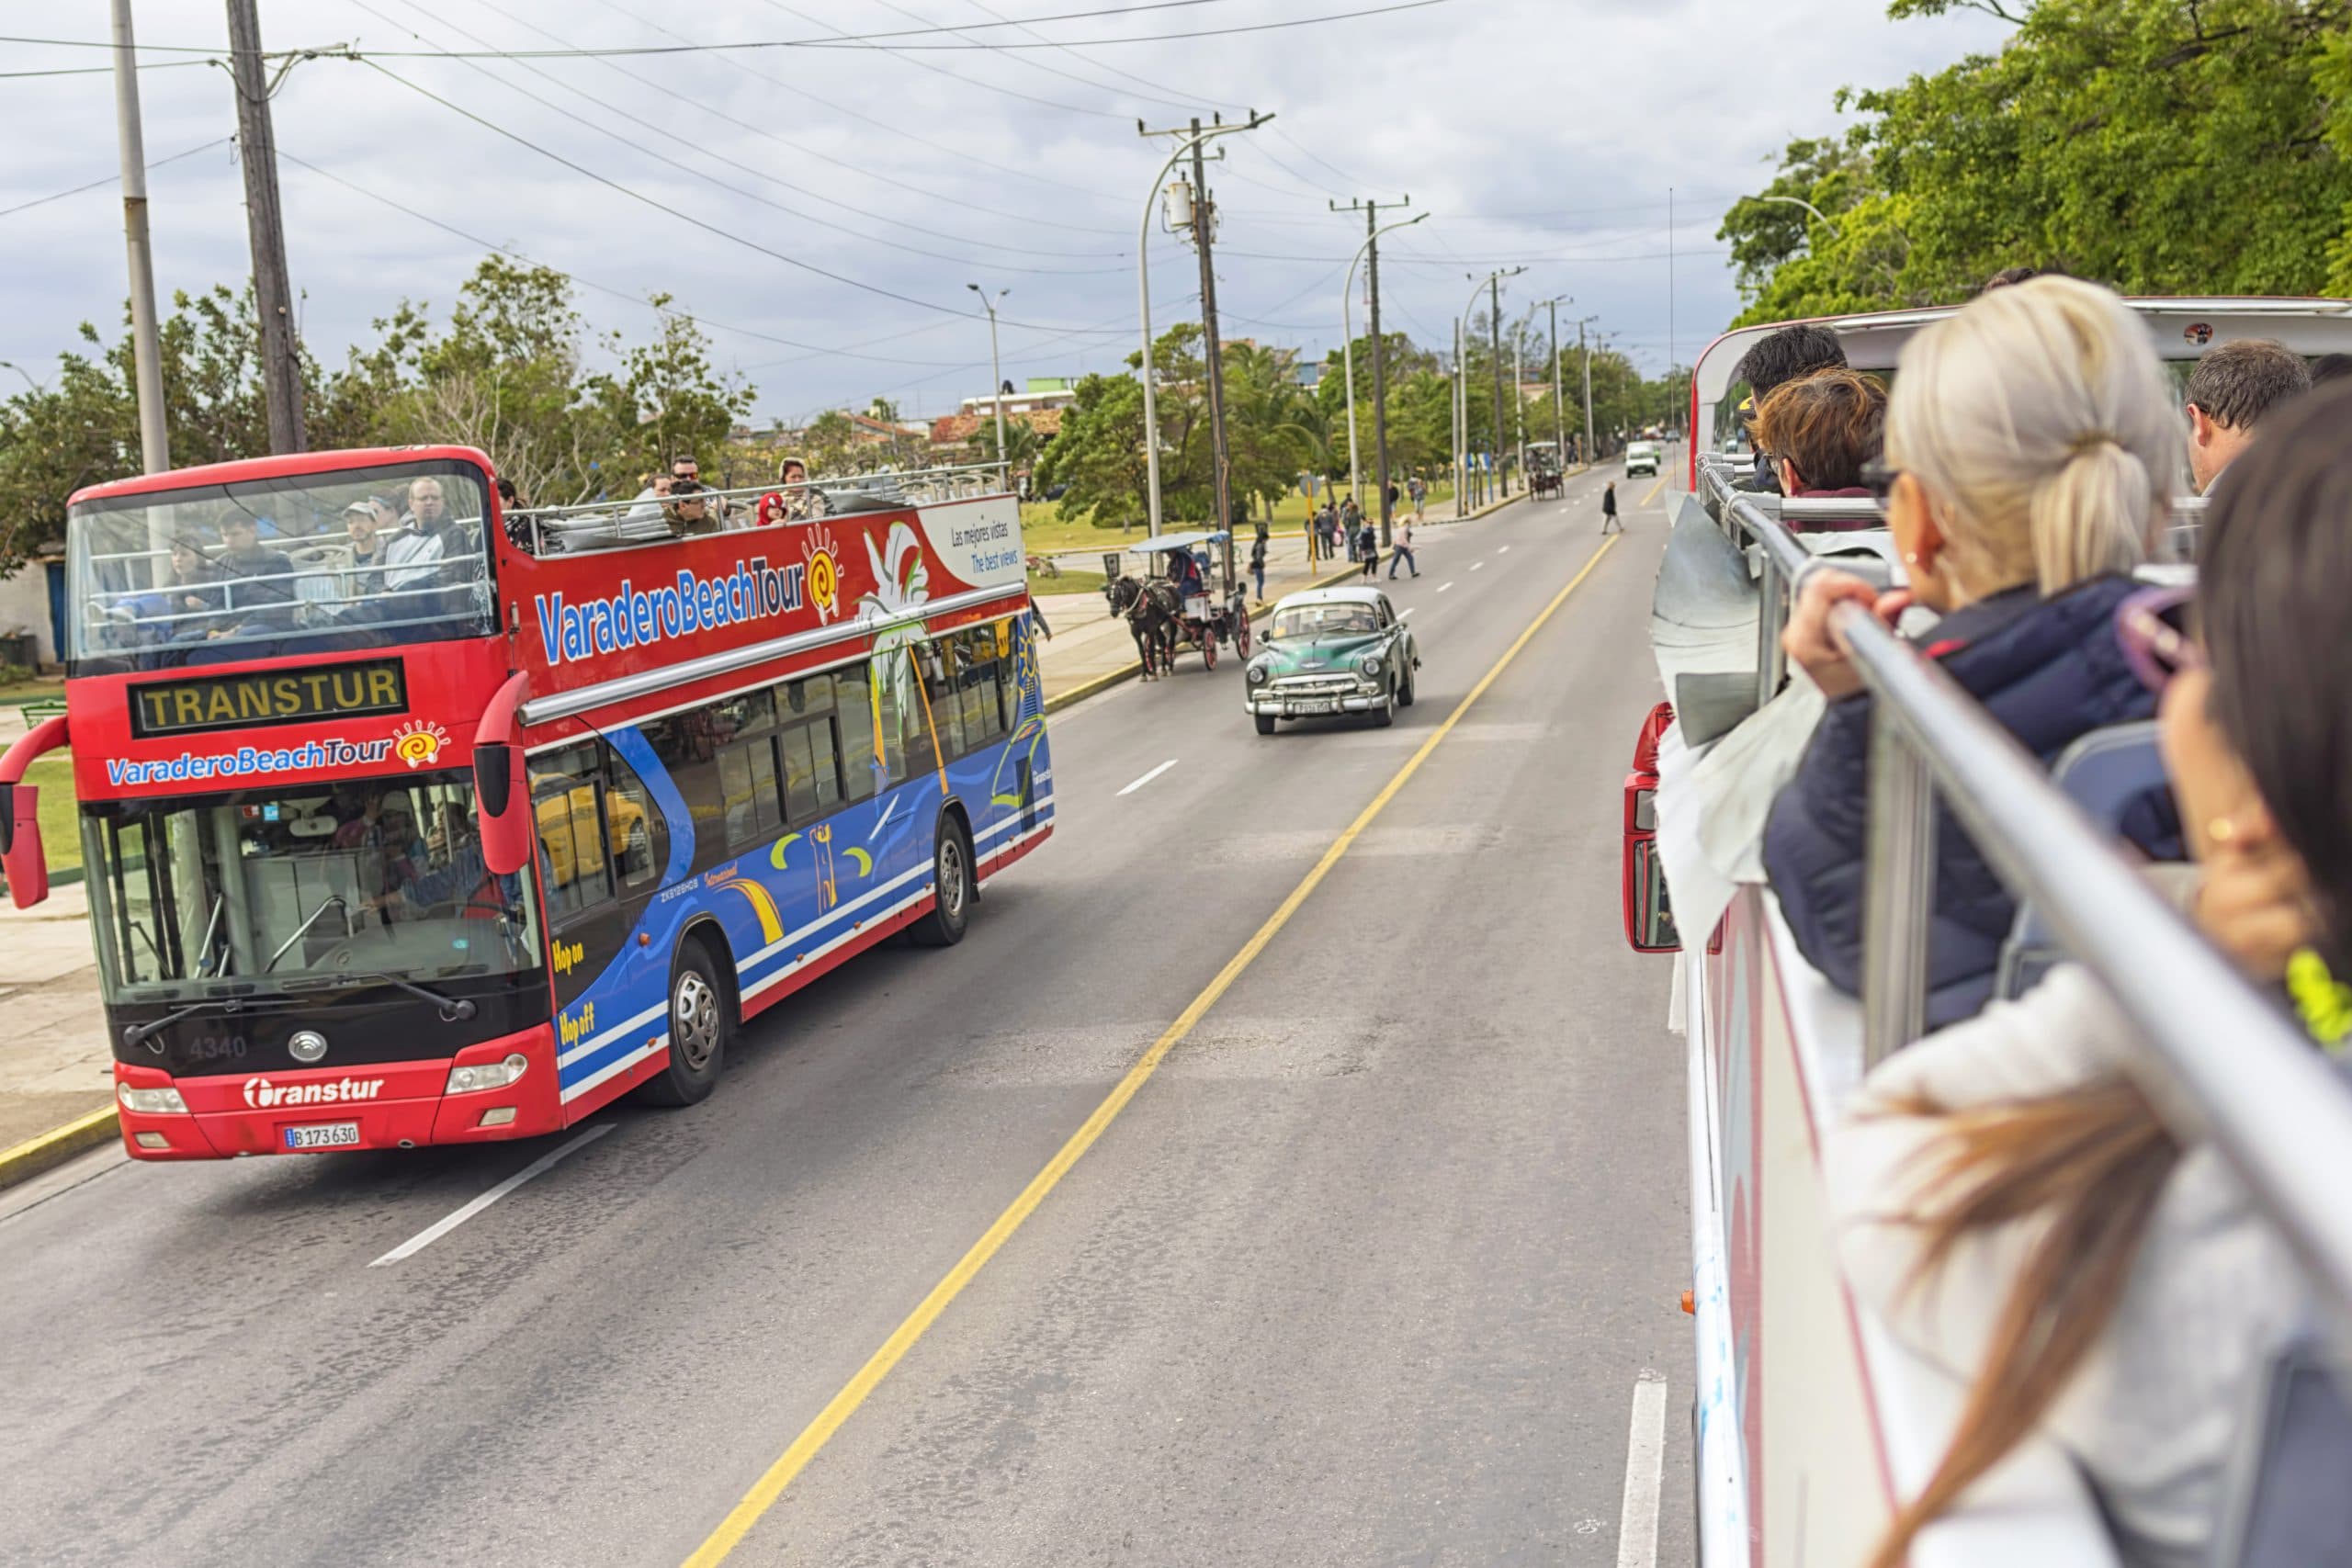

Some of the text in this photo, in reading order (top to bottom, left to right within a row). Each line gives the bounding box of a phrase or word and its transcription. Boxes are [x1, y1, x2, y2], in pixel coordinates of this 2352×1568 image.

[951, 520, 1008, 548] Las mejores vistas
[971, 547, 1017, 573] The best views
[535, 557, 804, 665] VaraderoBeachTour
[145, 669, 399, 727] TRANSTUR
[107, 739, 392, 785] VaraderoBeachTour
[552, 940, 583, 976] Hop on
[559, 1001, 594, 1047] Hop off
[190, 1035, 246, 1057] 4340
[294, 1127, 356, 1145] B 173 630
